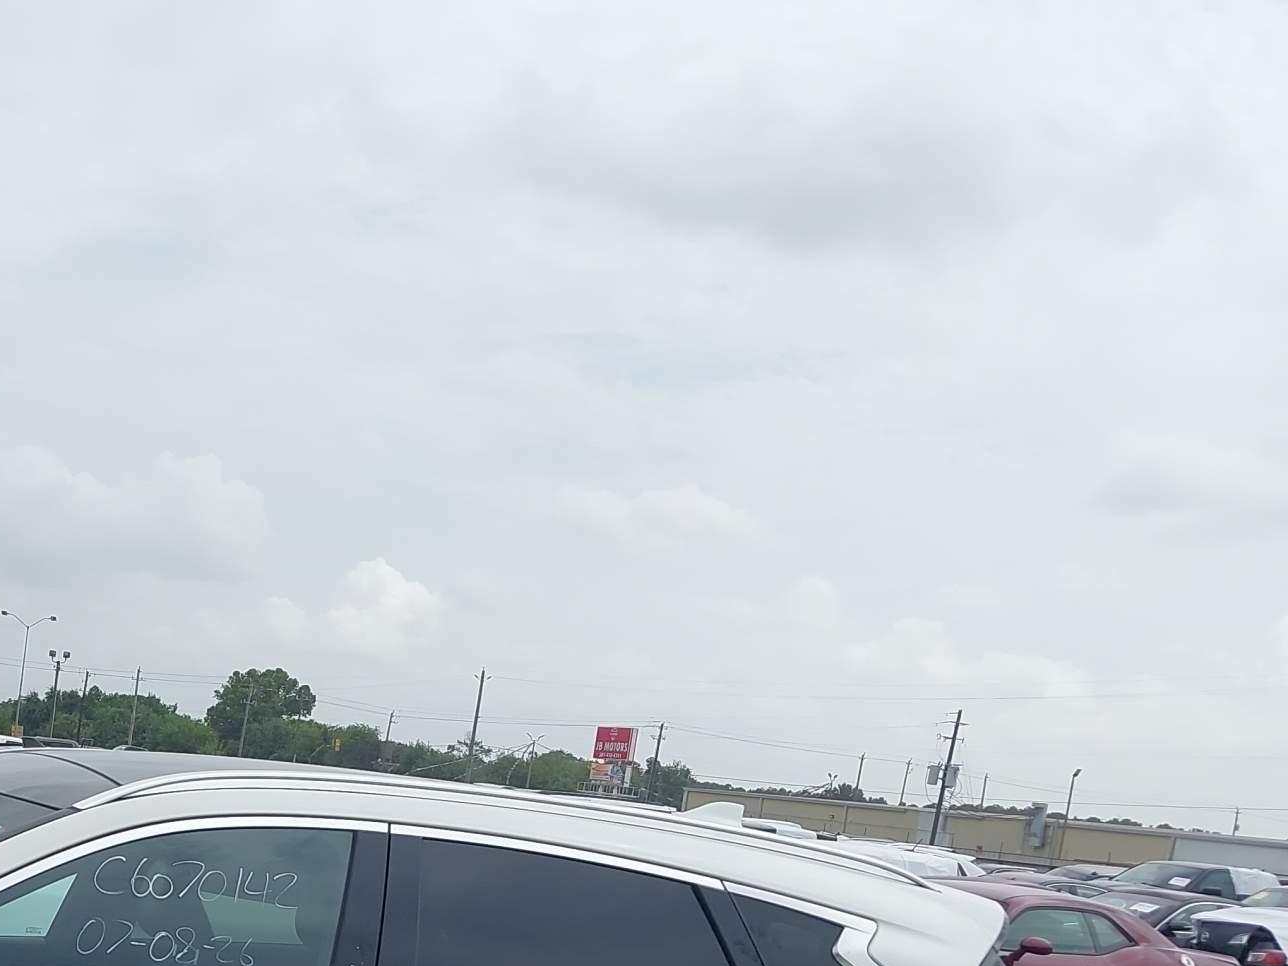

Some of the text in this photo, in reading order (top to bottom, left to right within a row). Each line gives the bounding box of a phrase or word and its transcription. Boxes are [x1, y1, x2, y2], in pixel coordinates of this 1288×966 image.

[604, 742, 628, 752] MOTORS
[93, 855, 299, 909] C6070142
[76, 916, 255, 966] 07-08-26
